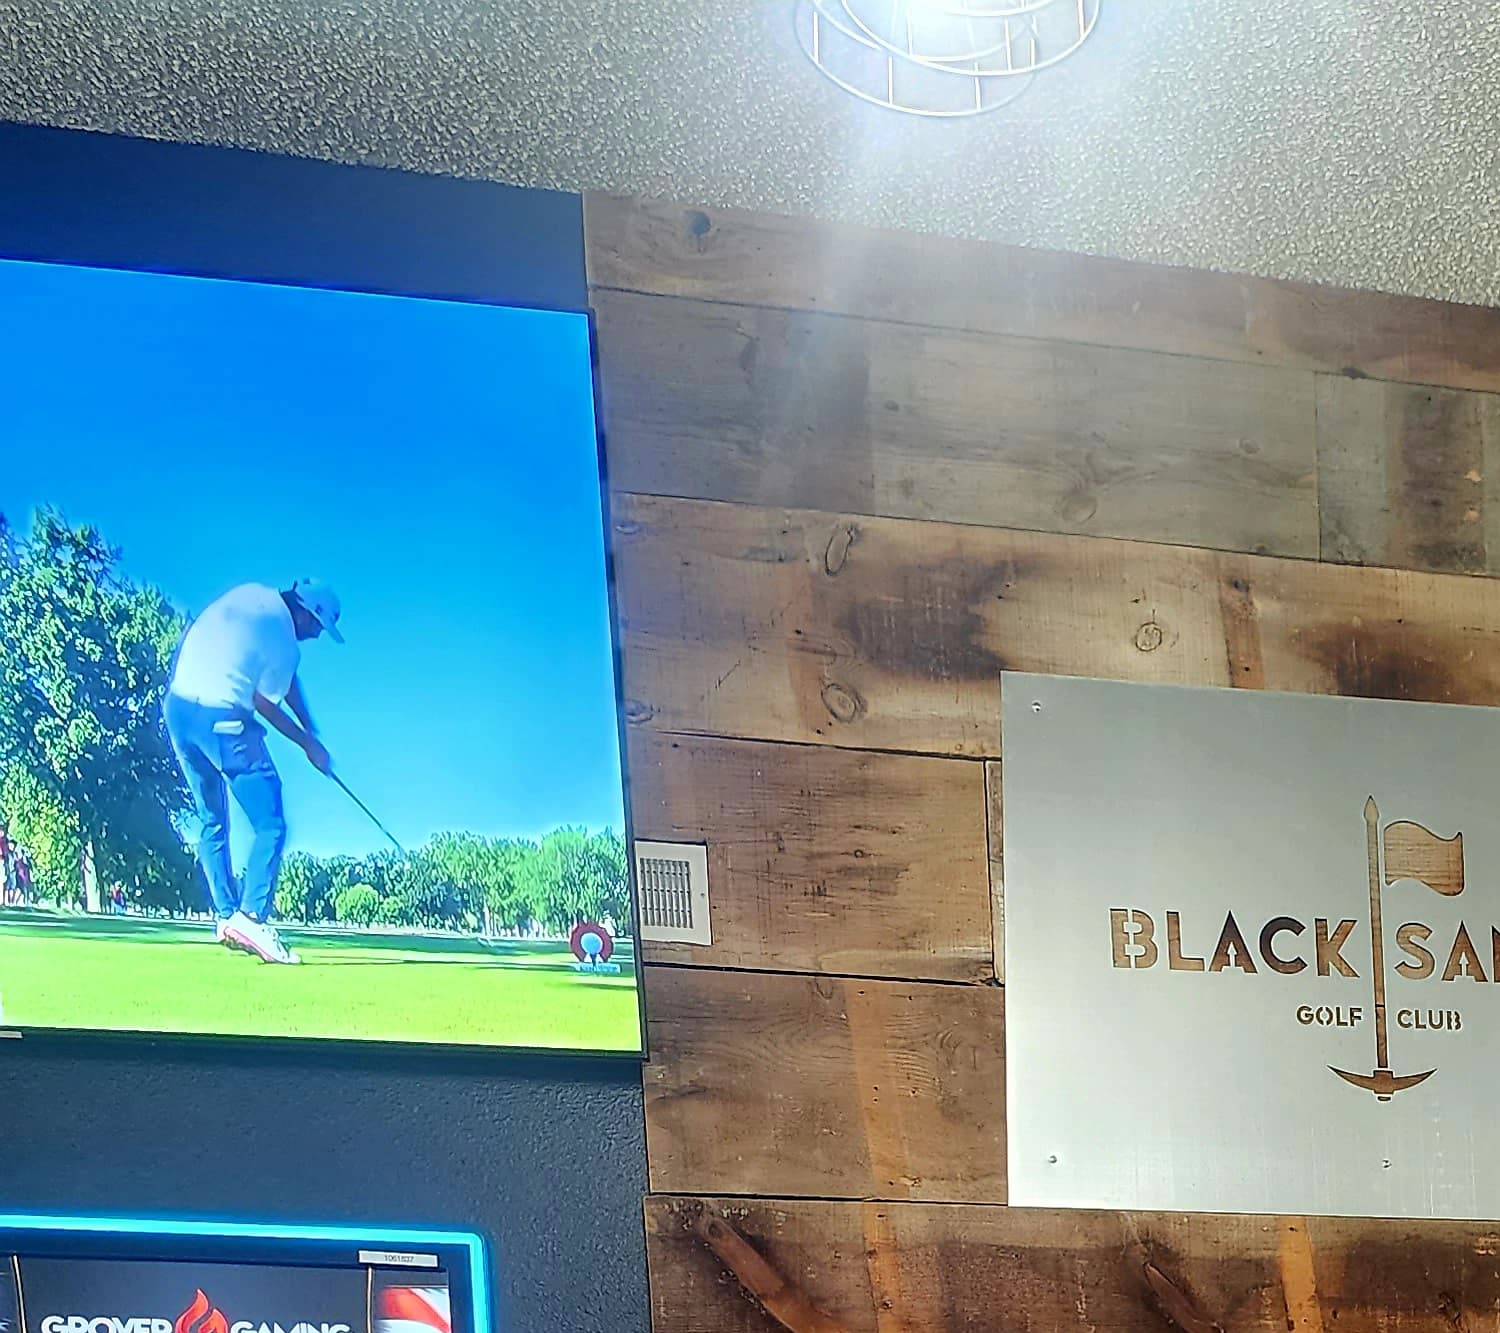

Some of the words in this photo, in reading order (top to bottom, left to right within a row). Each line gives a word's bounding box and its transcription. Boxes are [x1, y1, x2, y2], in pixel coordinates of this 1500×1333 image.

[1109, 907, 1361, 978] BLACK
[1295, 1004, 1363, 1028] GOLF
[1396, 1008, 1463, 1031] CLUB
